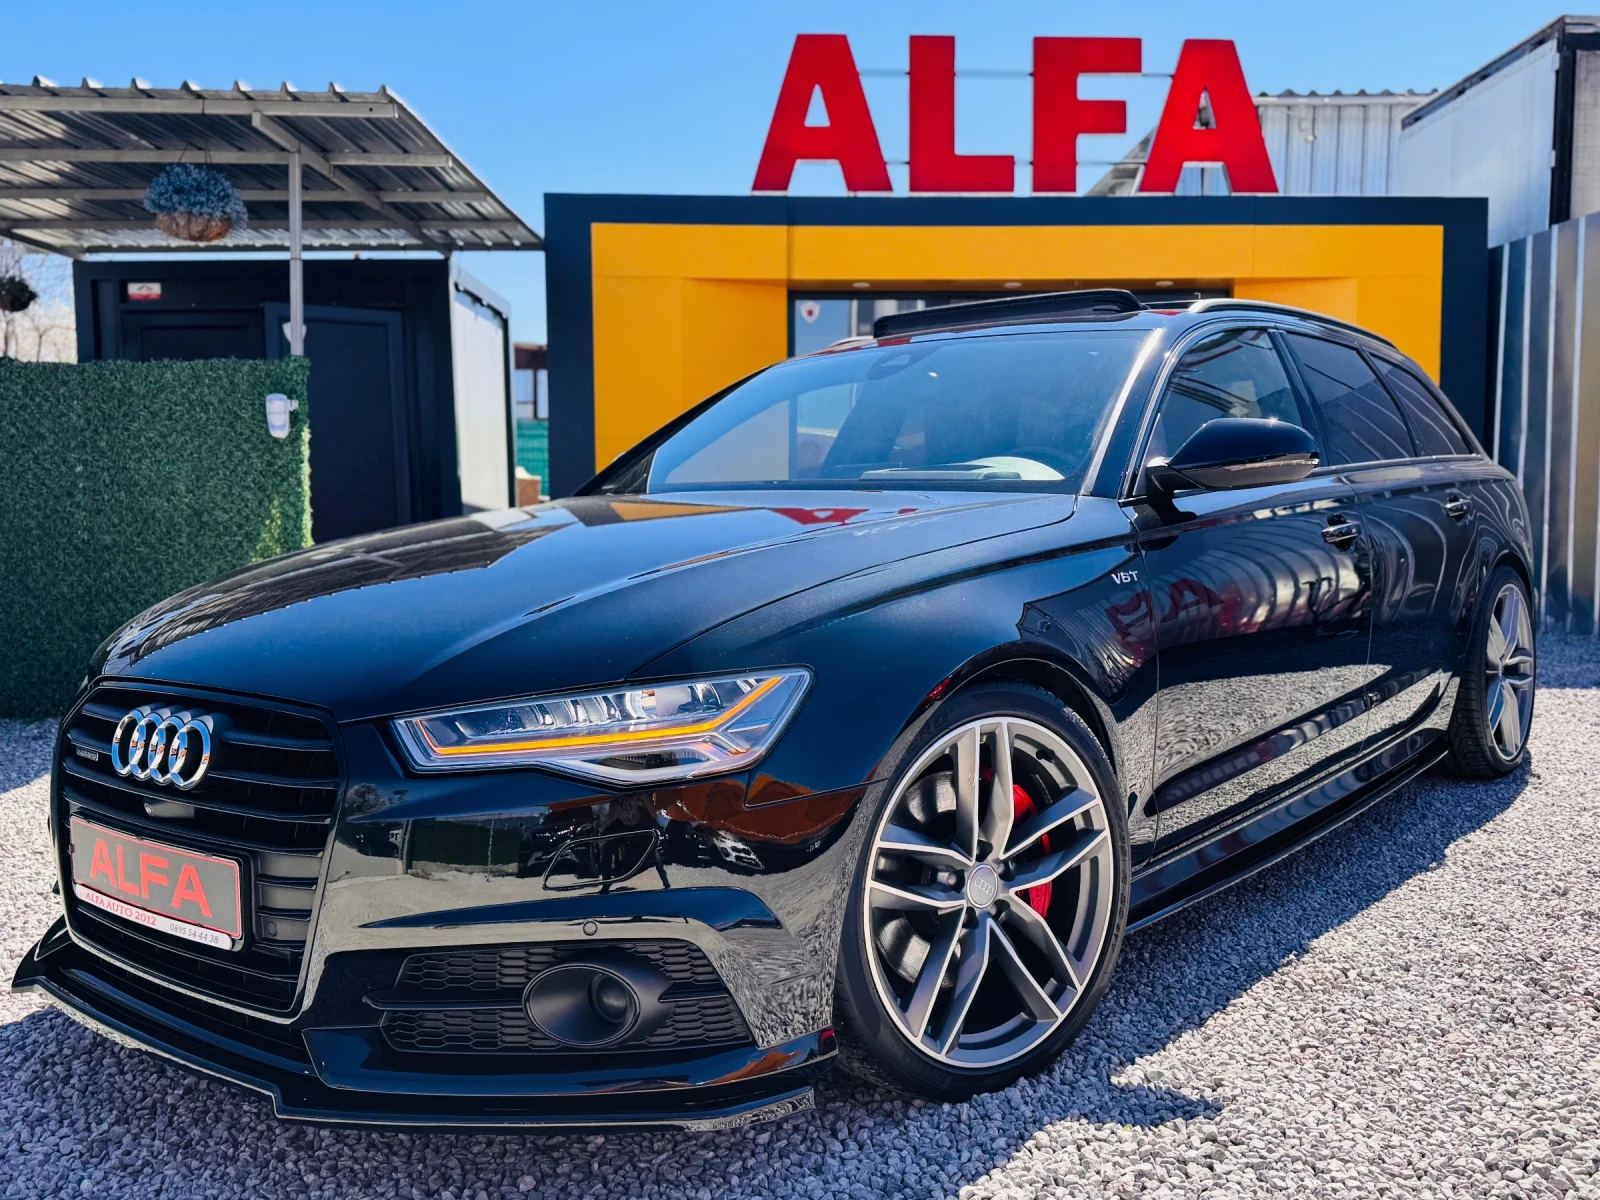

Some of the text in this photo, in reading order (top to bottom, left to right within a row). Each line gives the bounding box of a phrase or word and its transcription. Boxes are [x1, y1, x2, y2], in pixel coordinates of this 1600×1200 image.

[752, 34, 1278, 192] ALFA
[1111, 570, 1138, 585] V6T
[90, 838, 213, 918] ALFA
[85, 892, 220, 944] ALFA AUTO 2012 0895 54 44 38
